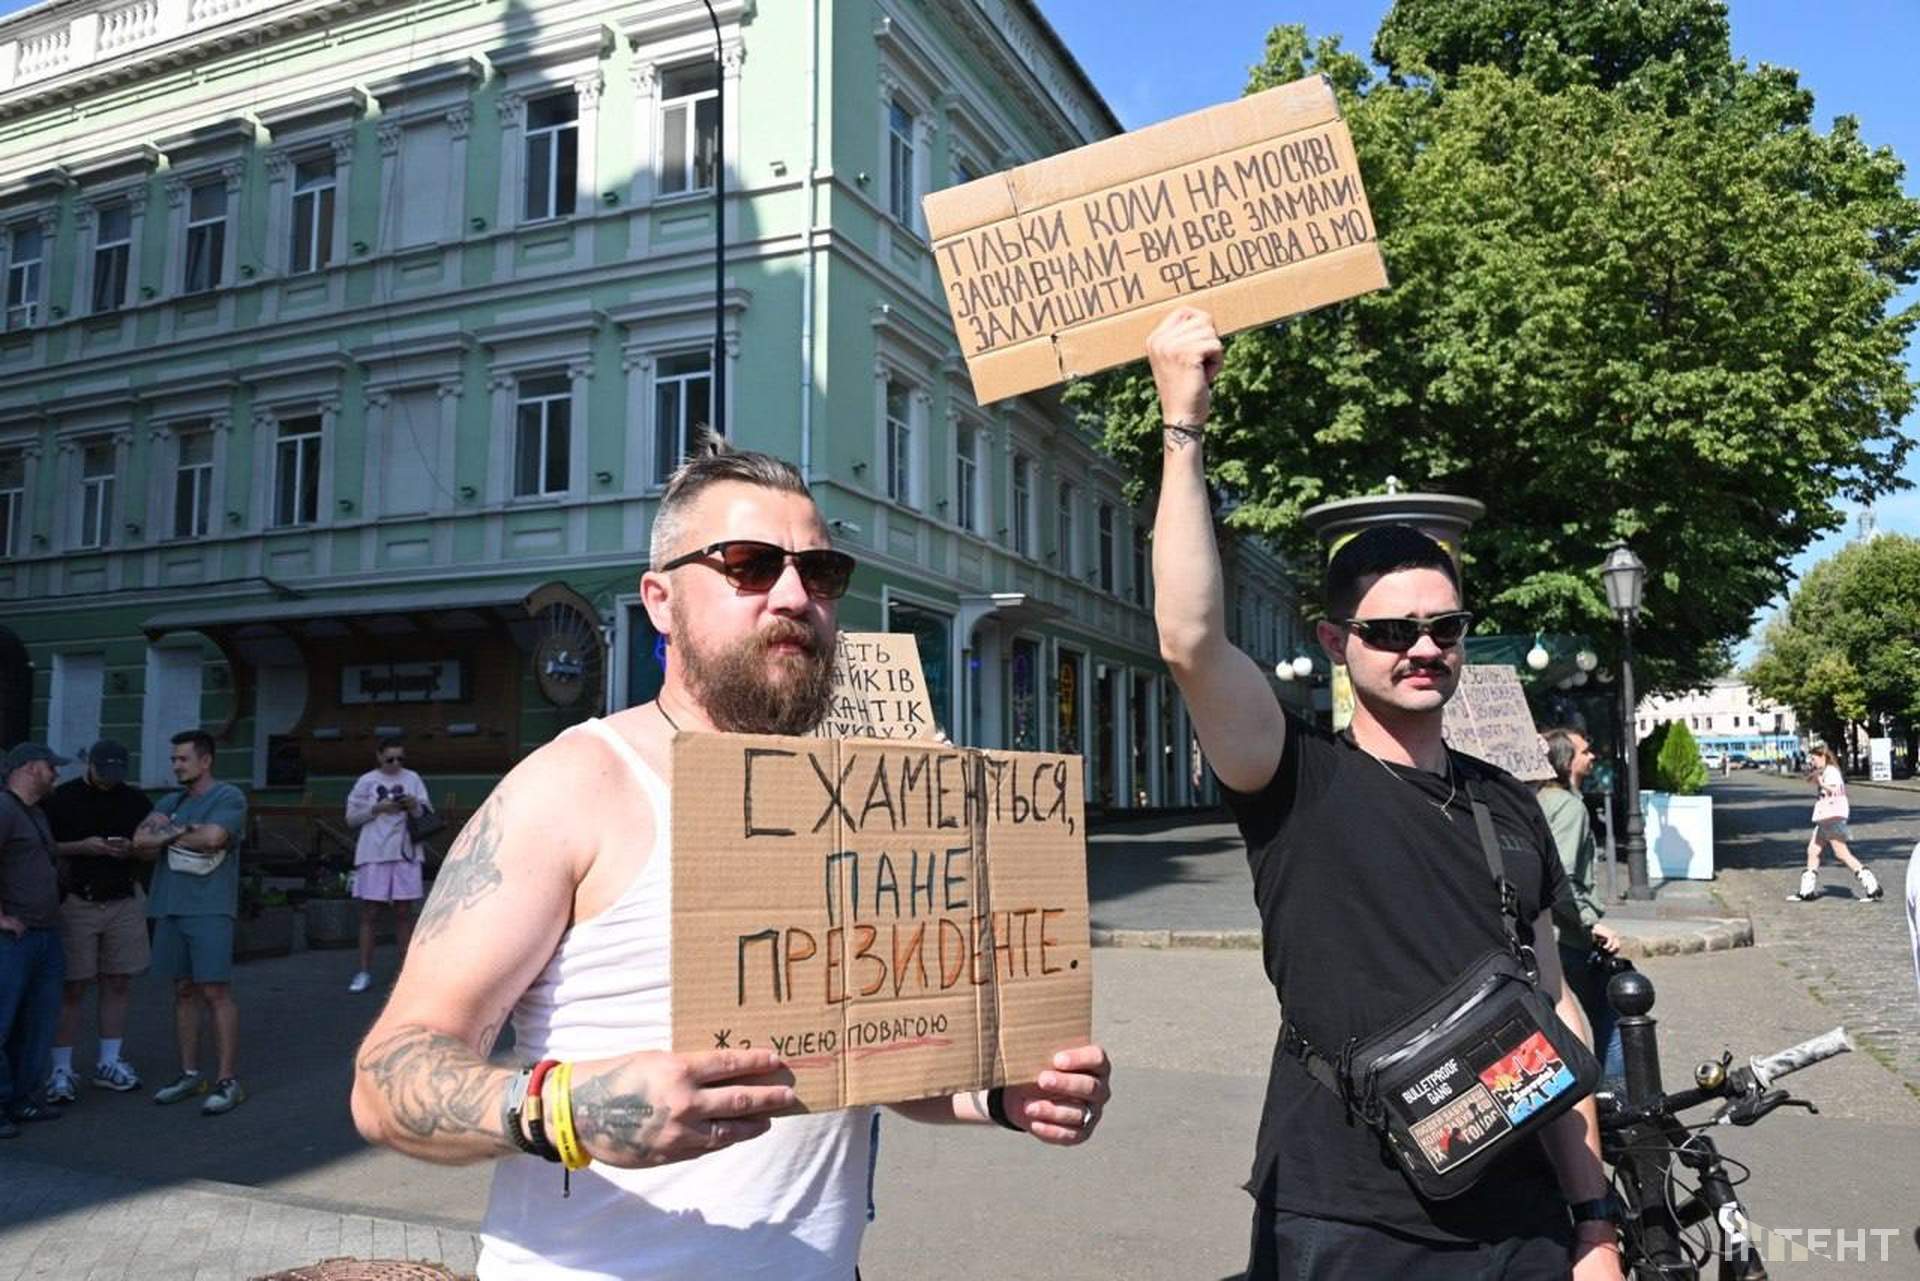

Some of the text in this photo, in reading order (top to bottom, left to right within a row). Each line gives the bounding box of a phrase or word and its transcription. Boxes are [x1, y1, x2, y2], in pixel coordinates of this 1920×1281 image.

[938, 133, 1339, 277] ТІЛЬКИ КОЛИ НА МОСКВІ
[1243, 173, 1362, 232] ЗЛАМАЛИ!
[969, 208, 1368, 352] ЗАЛИШИТИ ФЕДОРОВА В МО
[826, 848, 972, 926] ПАНЕ
[848, 1013, 948, 1046] ПОВАГОЮ
[1401, 1057, 1459, 1105] BULLETPROOF
